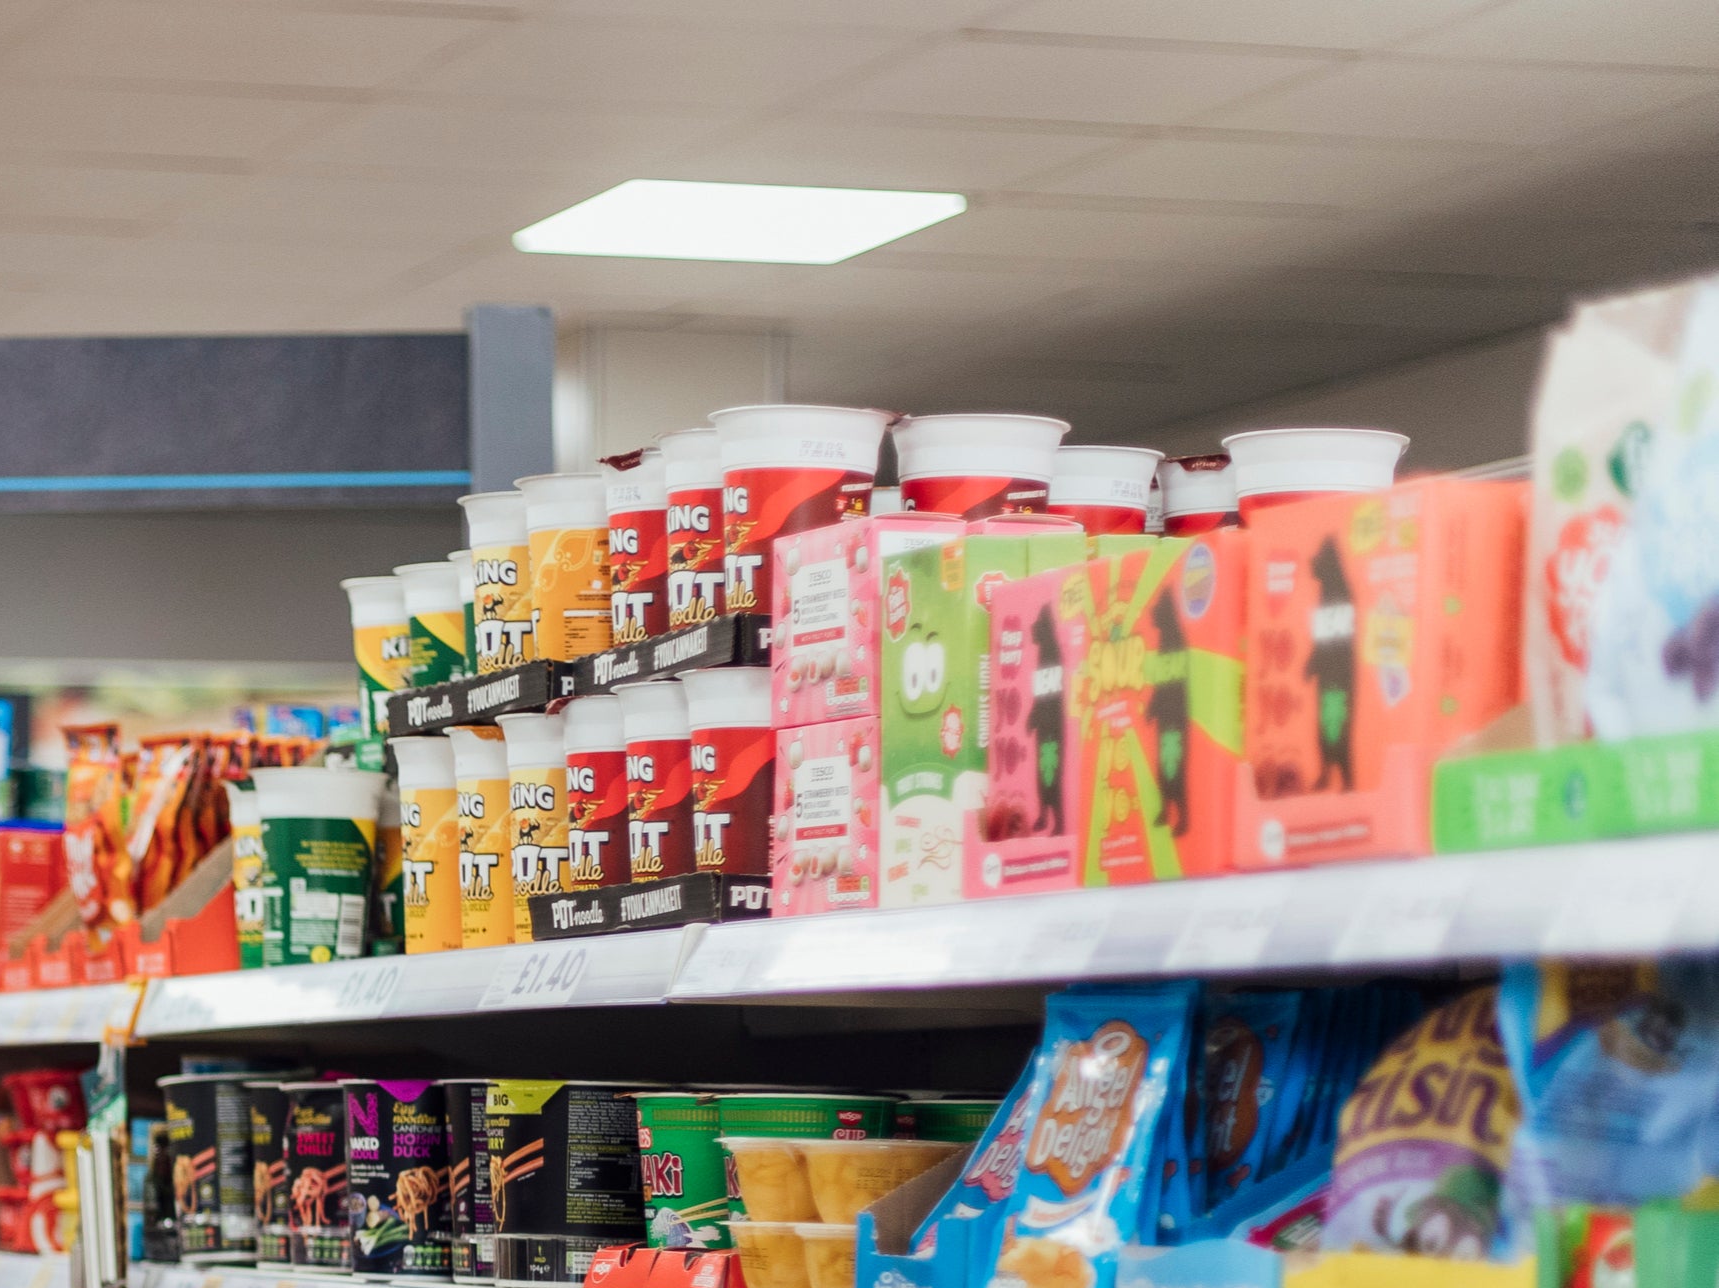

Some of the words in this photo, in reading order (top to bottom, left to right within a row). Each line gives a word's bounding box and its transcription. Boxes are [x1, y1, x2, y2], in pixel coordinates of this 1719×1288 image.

[809, 569, 833, 584] TESCO
[812, 766, 834, 778] TESCO
[621, 885, 681, 922] #YOUCANMAKEIT
[511, 949, 588, 997] £1.40
[493, 1094, 509, 1106] BIG
[393, 1102, 416, 1116] Egg
[394, 1134, 441, 1145] HOISIN
[1034, 1110, 1120, 1178] Delight
[393, 1146, 431, 1157] DUCK
